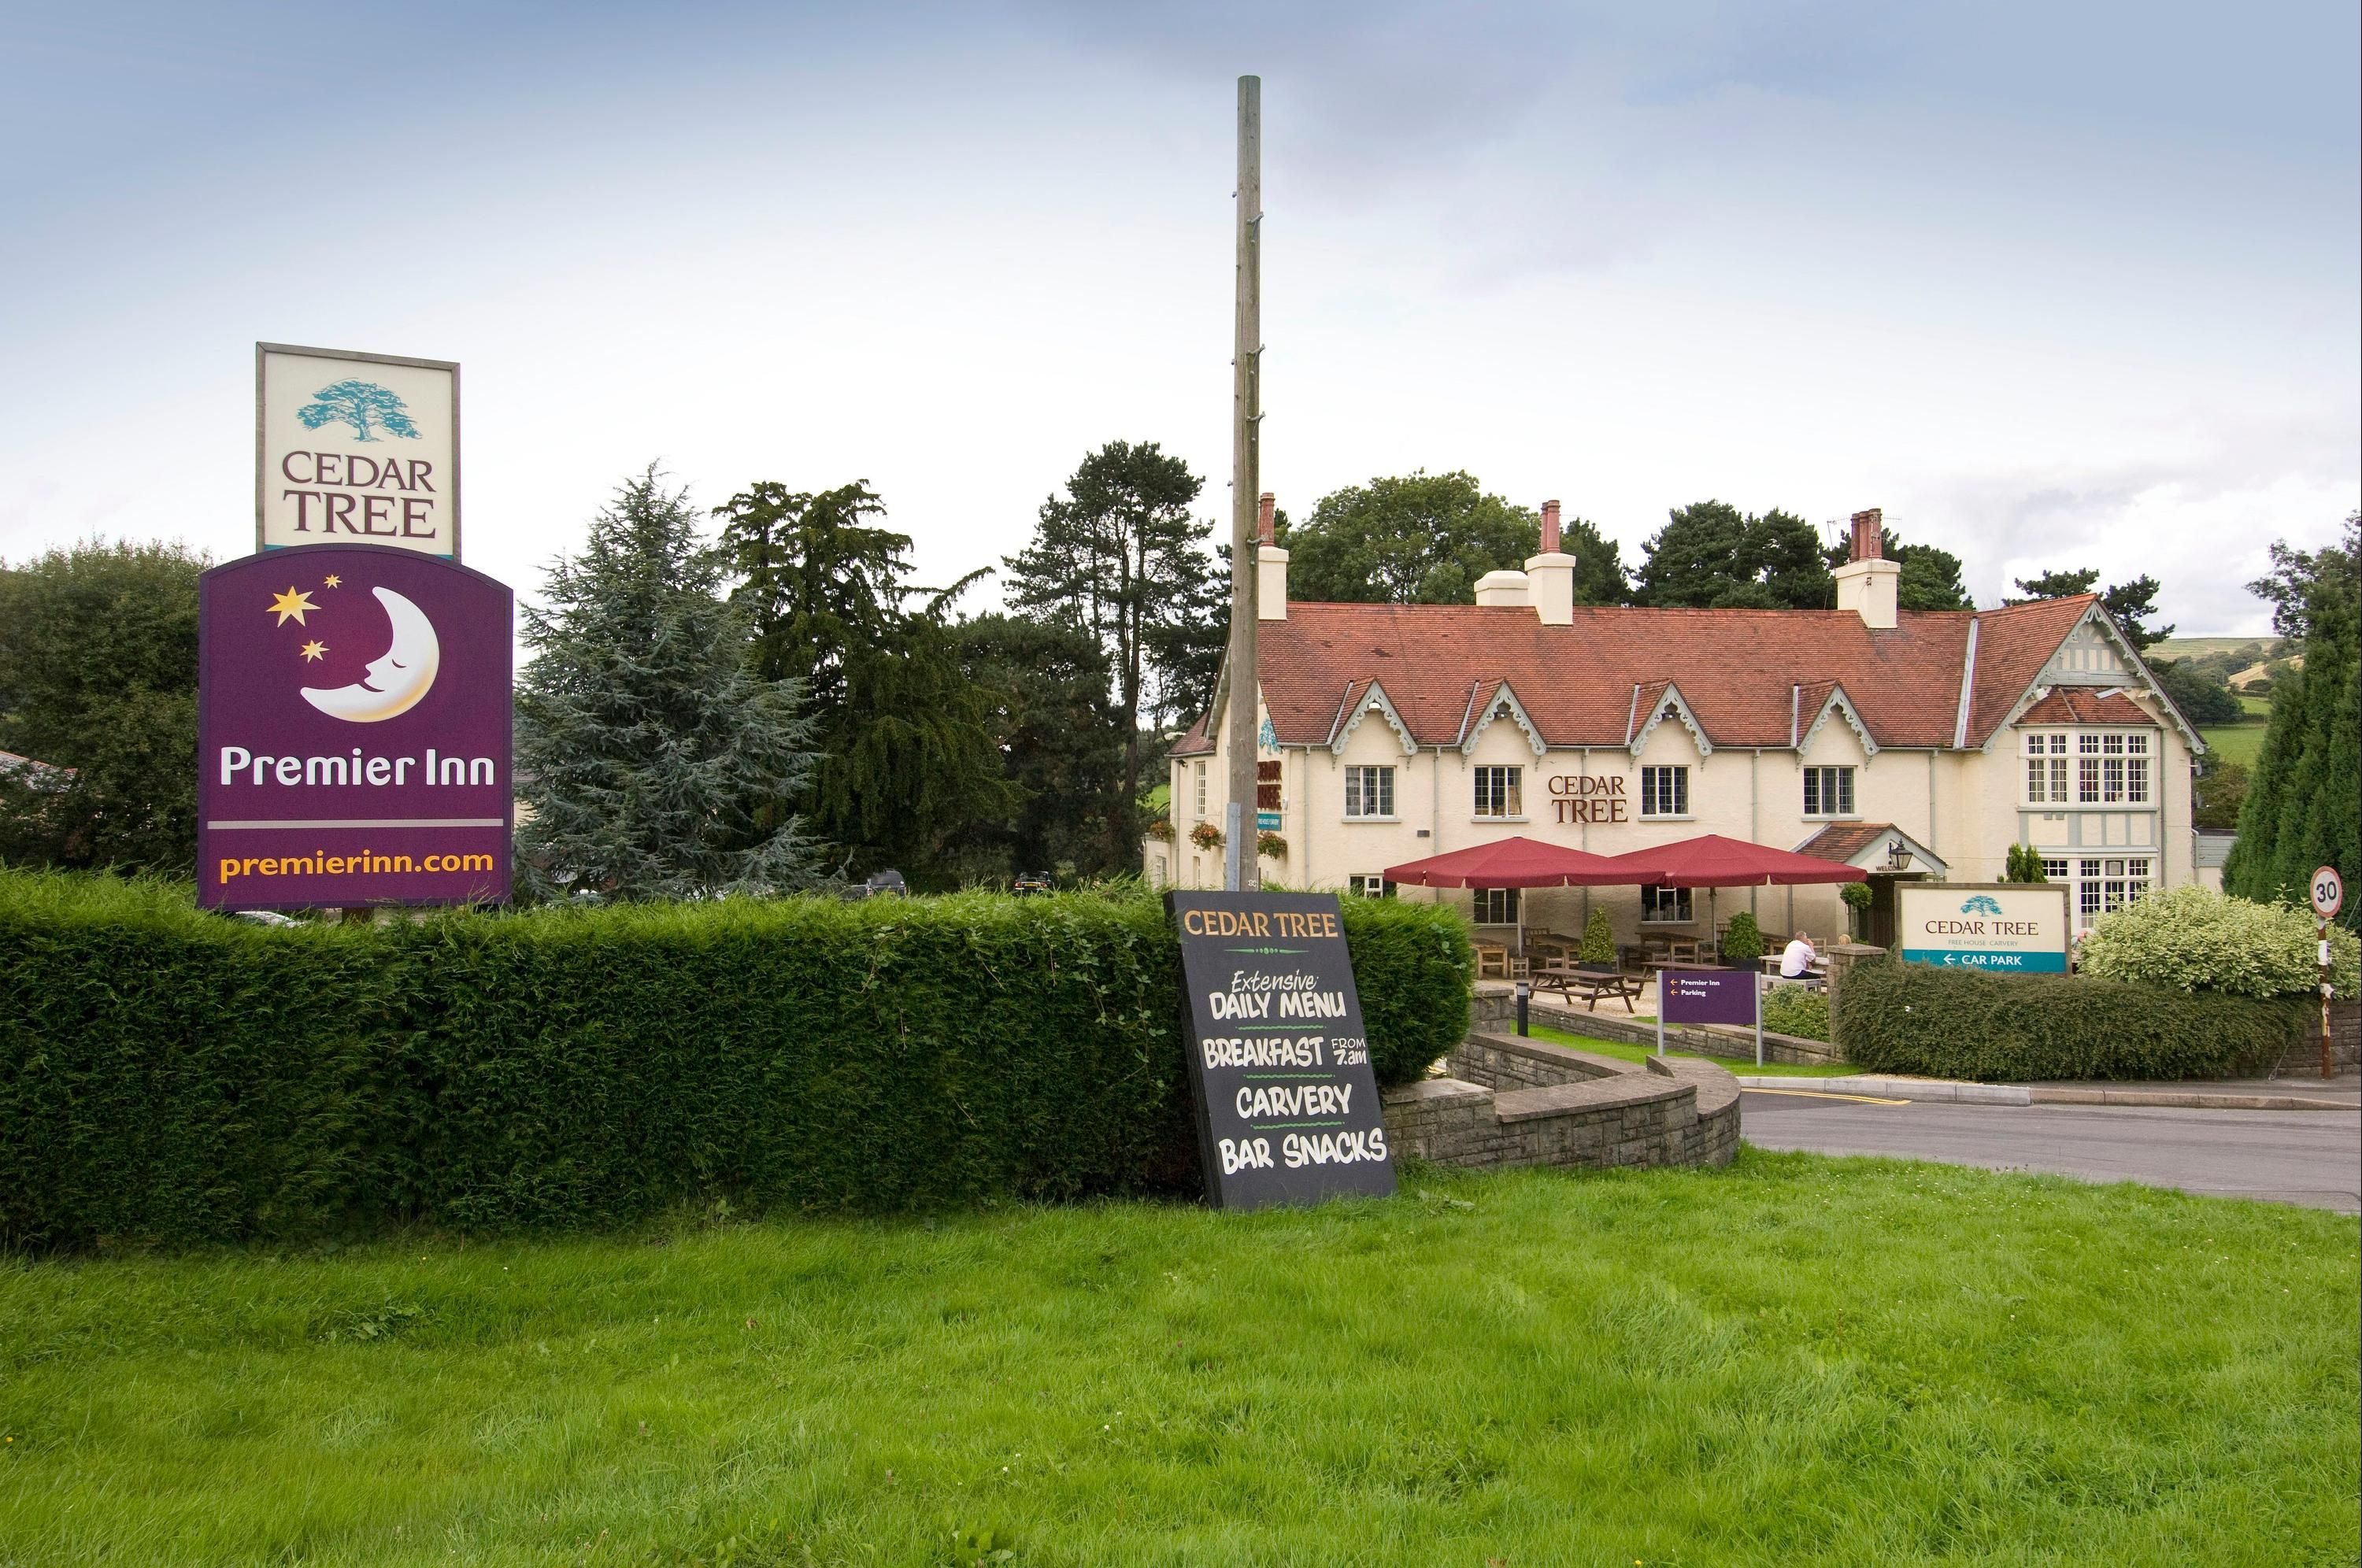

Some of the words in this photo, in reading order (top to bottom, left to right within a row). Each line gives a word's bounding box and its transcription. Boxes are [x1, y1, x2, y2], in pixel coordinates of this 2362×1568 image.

[282, 450, 436, 493] CEDAR
[283, 490, 436, 538] TREE
[220, 746, 416, 786] Premier
[426, 749, 495, 786] Inn
[1548, 775, 1627, 795] CEDAR
[1551, 799, 1628, 823] TREE
[219, 850, 494, 884] premierinn.com
[2316, 881, 2338, 903] 30
[1183, 910, 1272, 937] CEDAR
[1273, 912, 1338, 937] TREE
[1925, 920, 1985, 935] CEDAR
[1992, 922, 2039, 935] TREE
[1961, 955, 1987, 965] CAR
[1990, 955, 2022, 966] PARK
[1231, 969, 1317, 992] Extensive
[1209, 992, 1271, 1020] DAILY
[1279, 991, 1347, 1019] MENU
[1203, 1036, 1324, 1069] BREAKFAST
[1331, 1037, 1366, 1049] FROM
[1235, 1083, 1353, 1119] CARVERY
[1219, 1137, 1275, 1175] BAR
[1283, 1127, 1387, 1168] SNACKS
